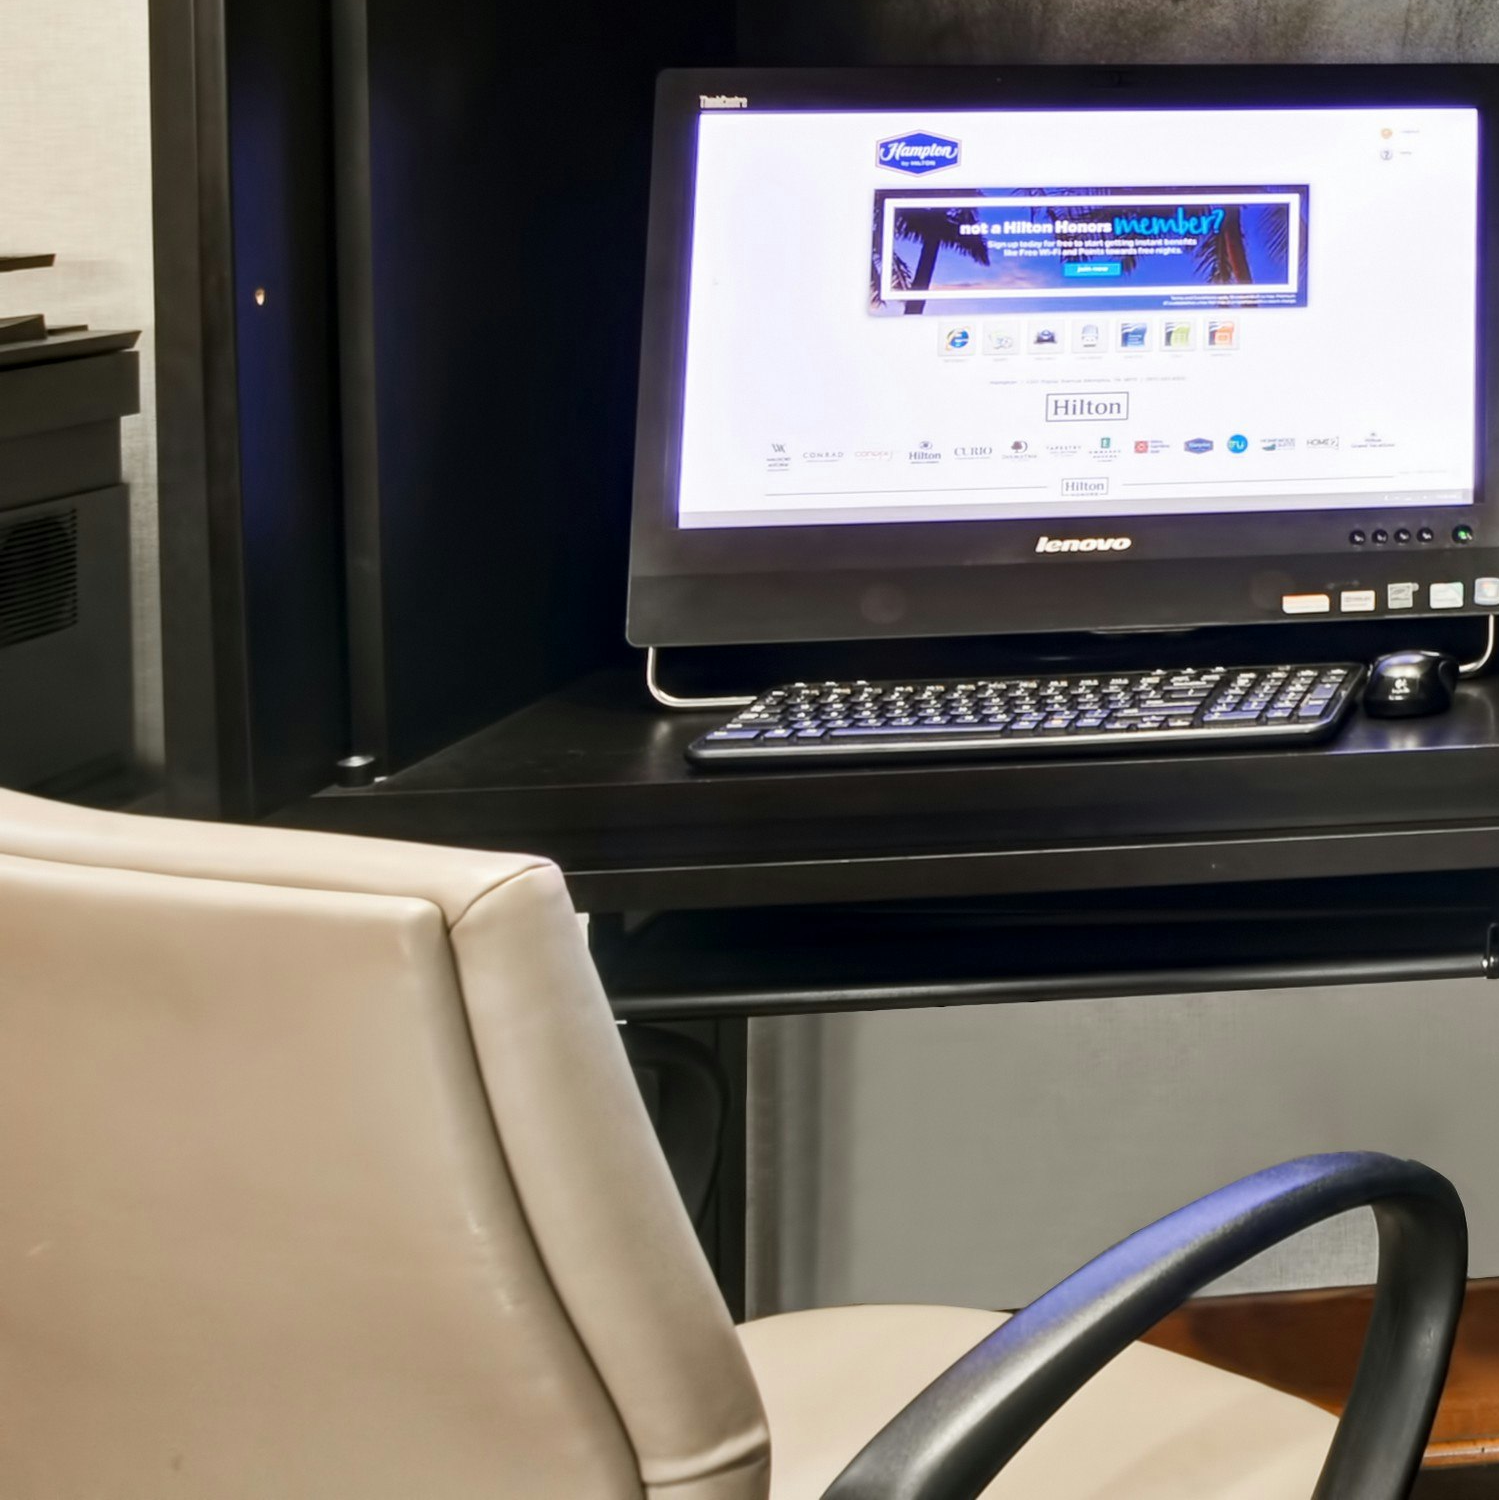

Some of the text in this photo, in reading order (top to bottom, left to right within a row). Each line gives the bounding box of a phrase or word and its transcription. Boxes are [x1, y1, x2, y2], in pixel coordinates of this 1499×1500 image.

[879, 141, 959, 161] Hampton
[959, 207, 1225, 236] not a Hilton Honors member?
[1053, 399, 1122, 416] Hilton
[909, 451, 942, 461] Hilton
[954, 447, 993, 456] CURIO
[1065, 481, 1105, 491] Hilton
[1035, 536, 1132, 553] lenovo
